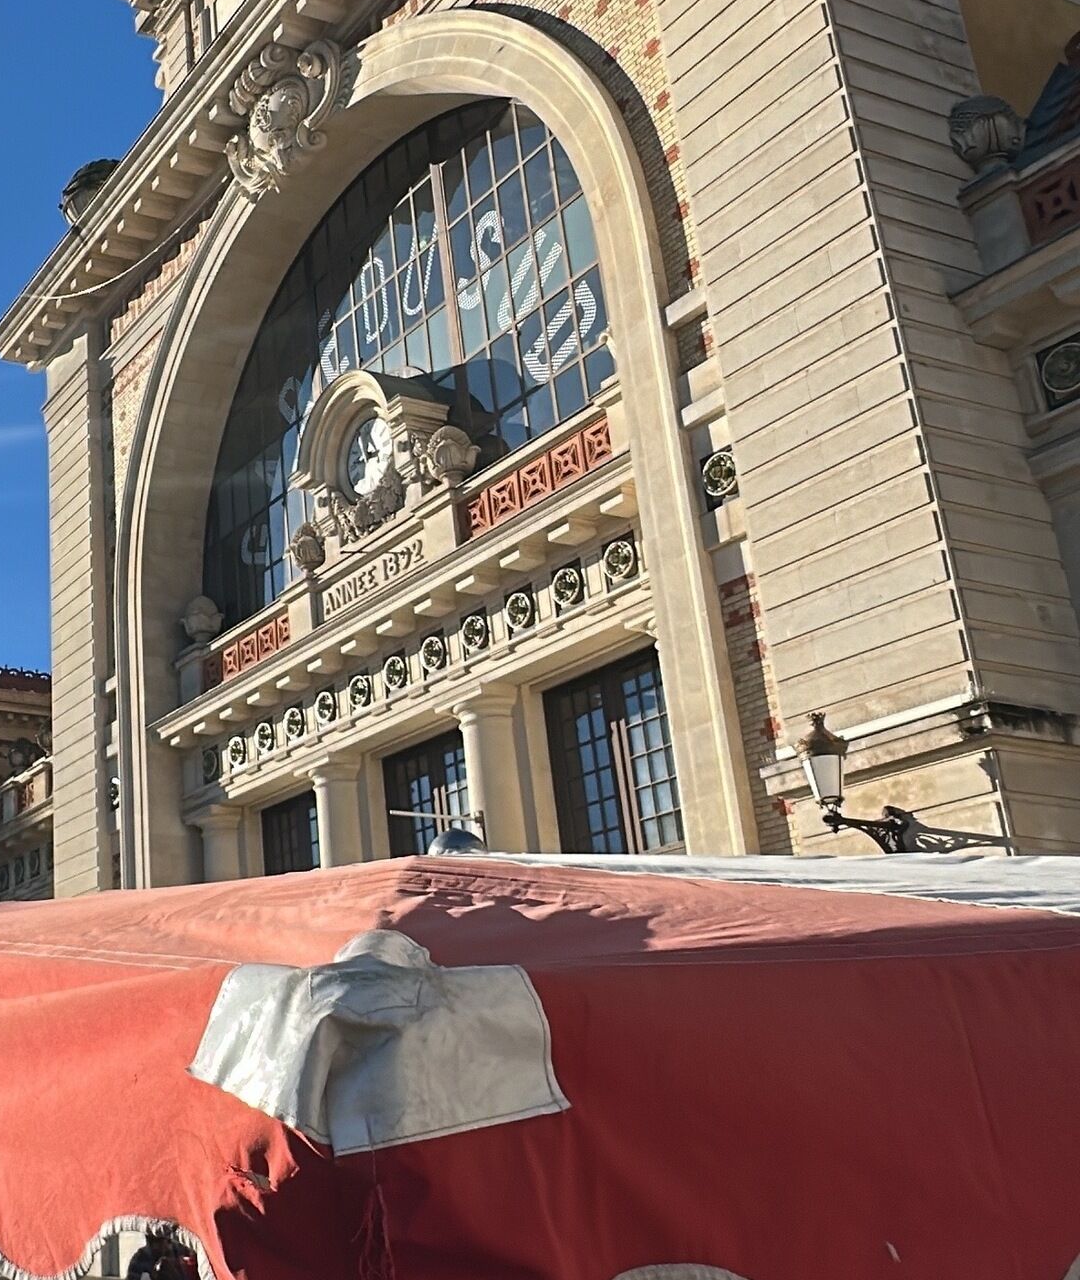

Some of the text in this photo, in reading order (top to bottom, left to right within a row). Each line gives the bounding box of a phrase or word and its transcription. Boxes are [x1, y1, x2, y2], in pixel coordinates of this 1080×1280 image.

[360, 222, 439, 345] DU
[457, 210, 598, 384] SUD
[325, 539, 424, 615] ANNEE 1892
